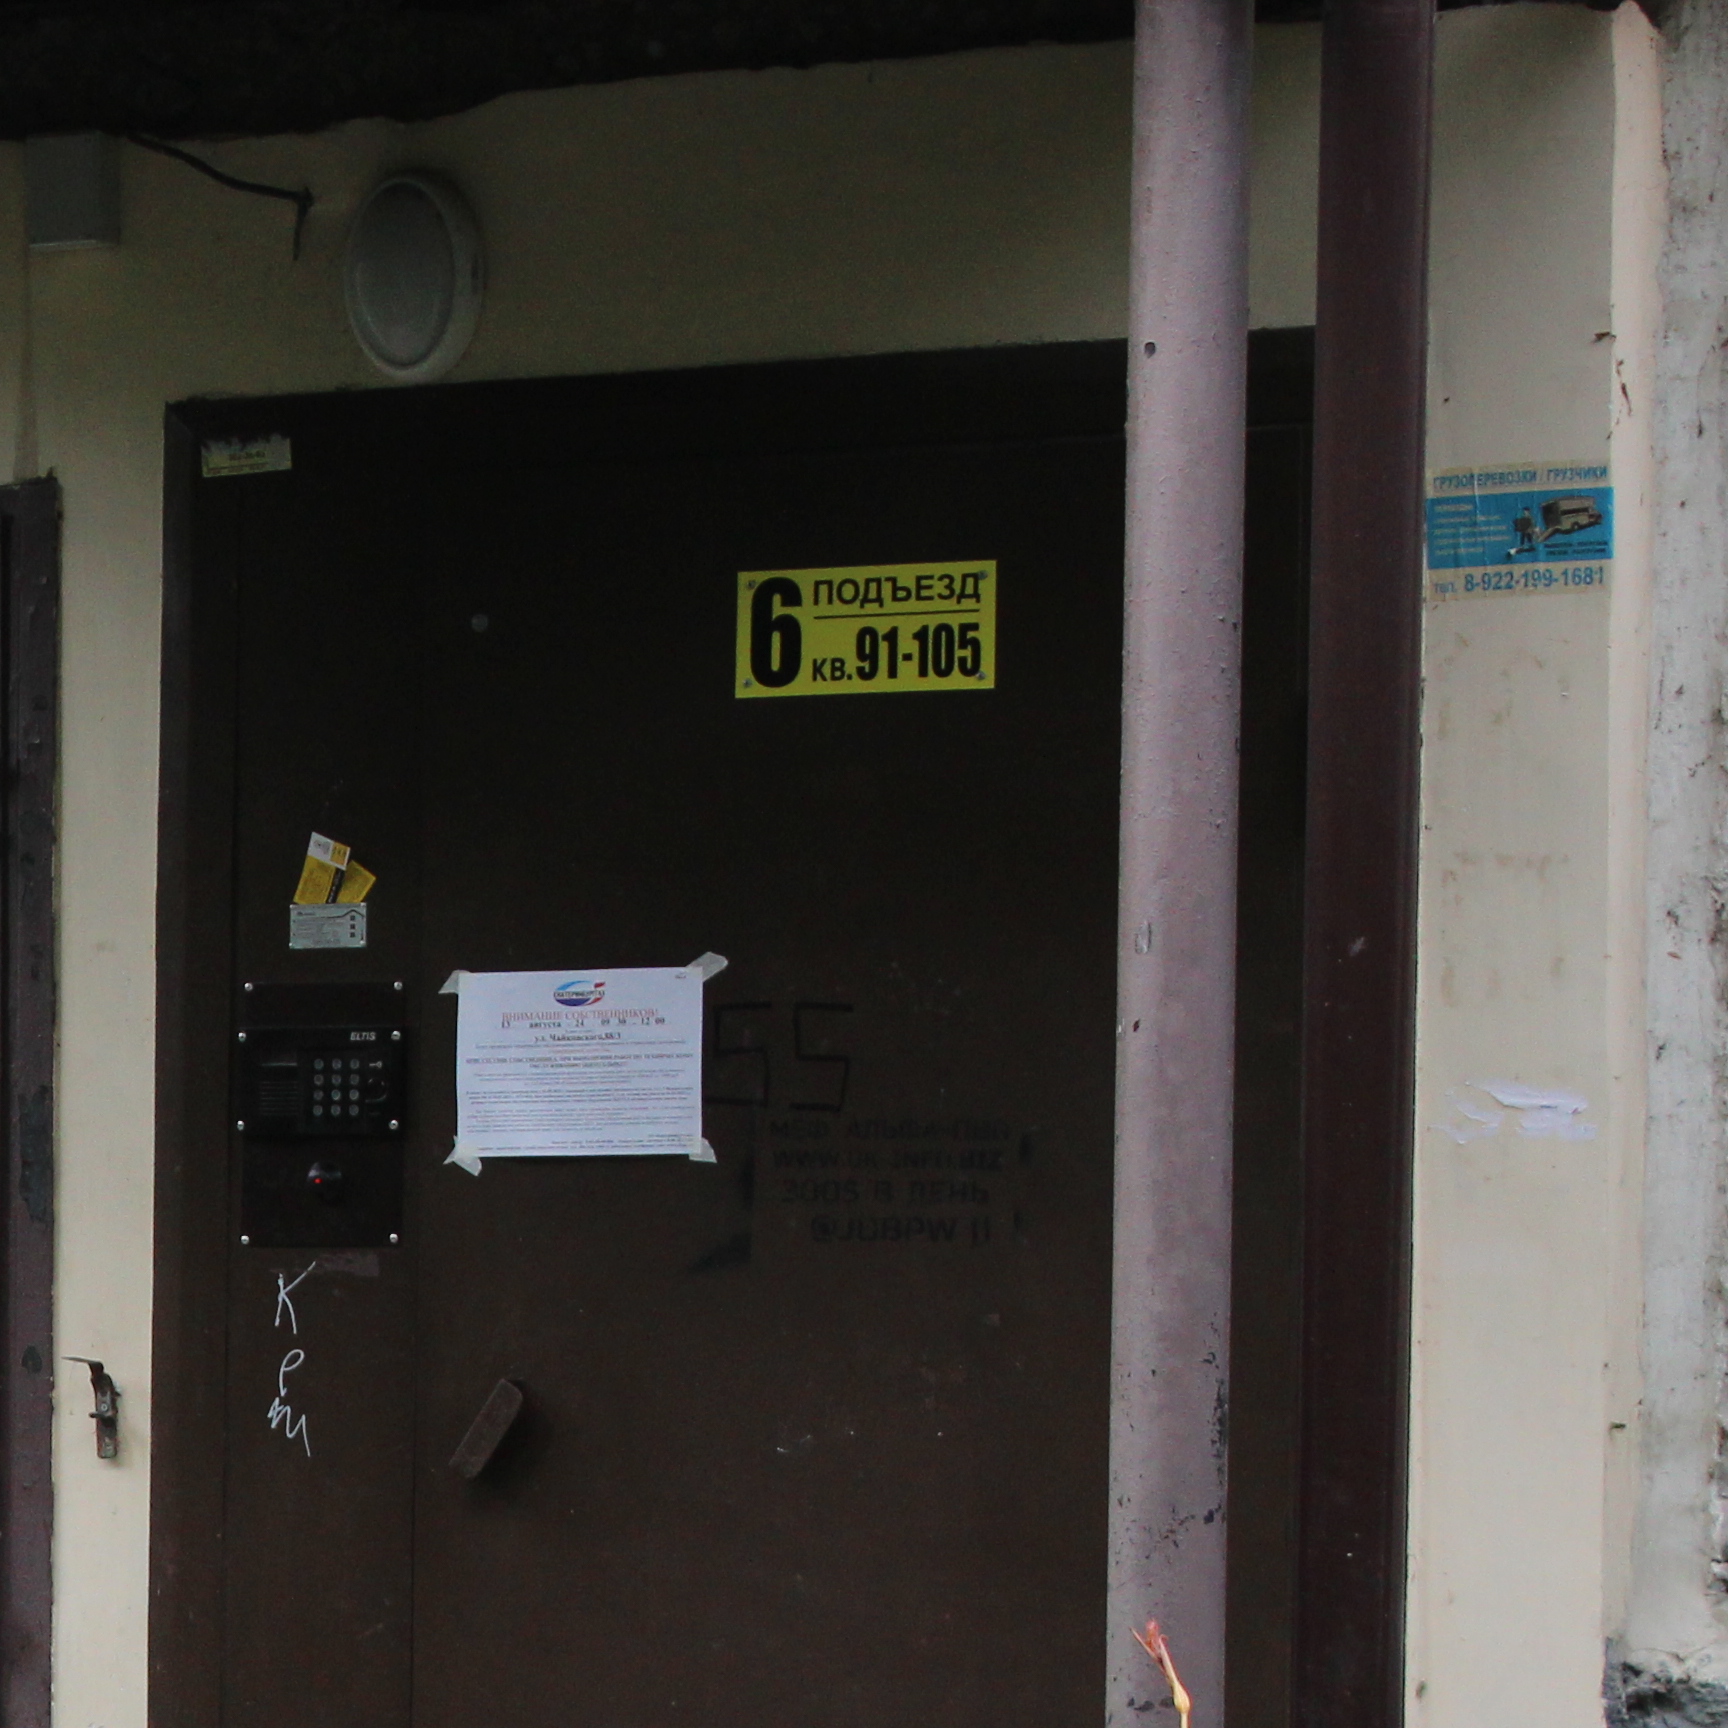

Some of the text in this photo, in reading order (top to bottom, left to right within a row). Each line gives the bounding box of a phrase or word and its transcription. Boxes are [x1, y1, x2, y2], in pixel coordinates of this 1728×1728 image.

[1433, 465, 1607, 491] ГРУЗОПЕРЕВОЗКИ ГРУЗЧИКИ
[1464, 566, 1604, 593] 8-922-199-1681
[750, 572, 981, 688] 6 ПОДЪЕЗД
[501, 1008, 658, 1022] ВНИМАНИЕ СОБСТВЕННИКОВ!
[529, 1020, 562, 1029] августа
[349, 1031, 376, 1041] ELTIS
